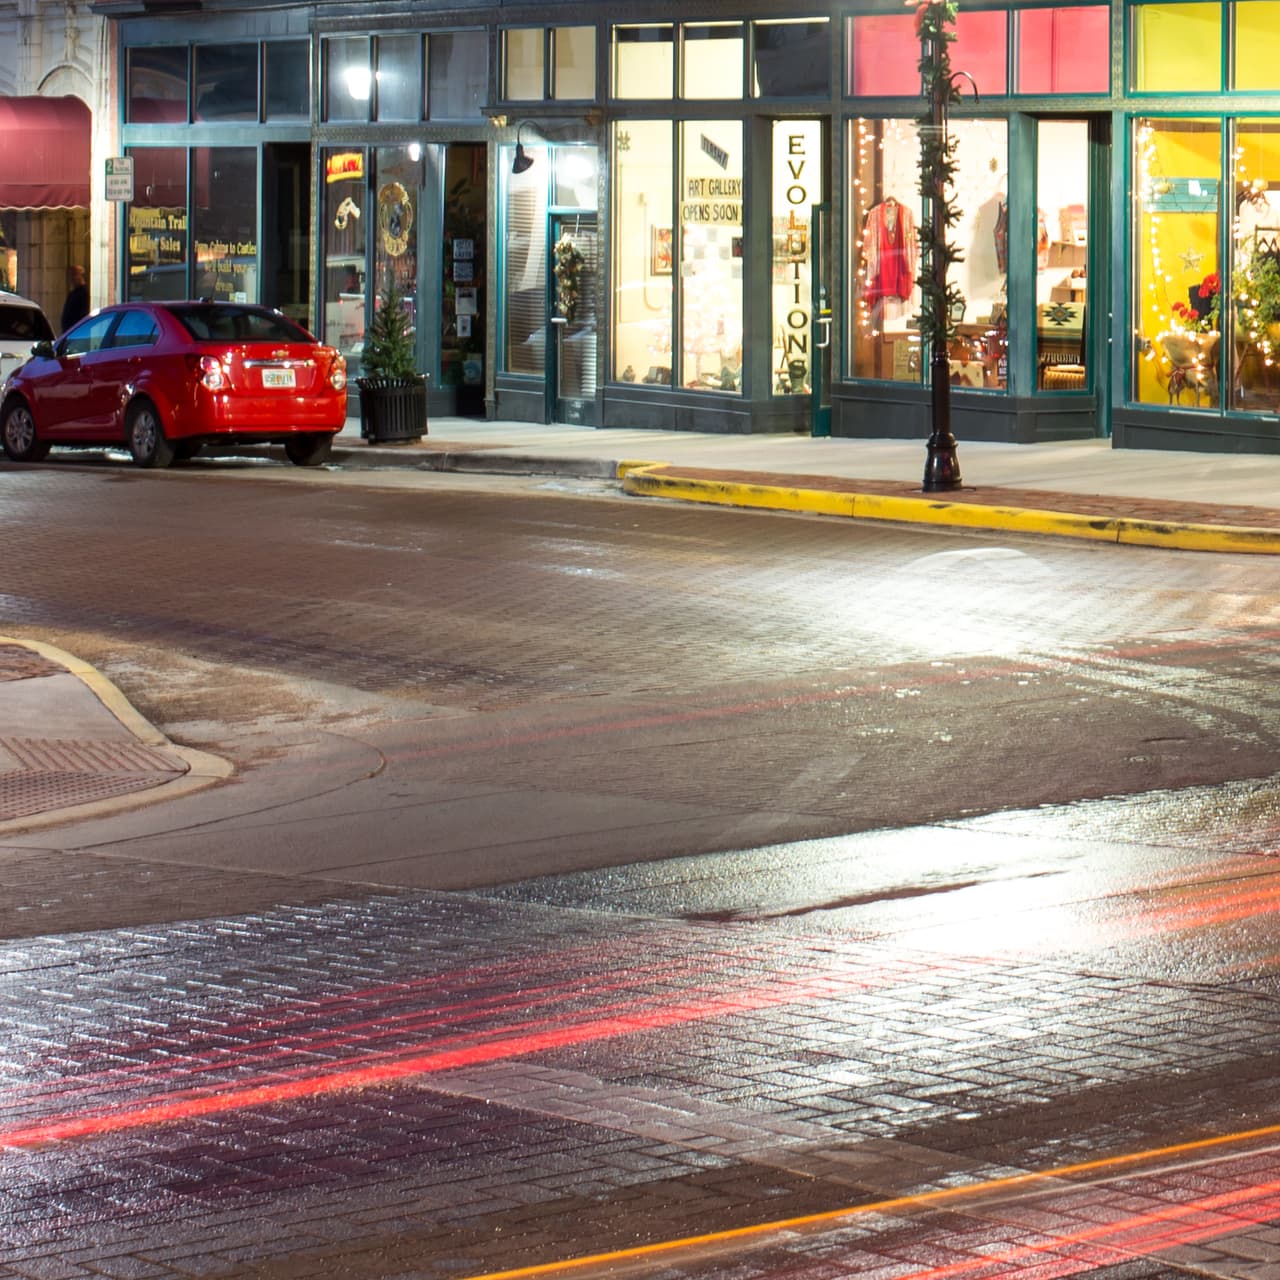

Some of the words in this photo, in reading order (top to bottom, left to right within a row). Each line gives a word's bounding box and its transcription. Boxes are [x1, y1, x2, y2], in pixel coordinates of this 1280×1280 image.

[688, 178, 705, 197] ART
[708, 178, 741, 197] GALLERY
[683, 204, 710, 221] OPENS
